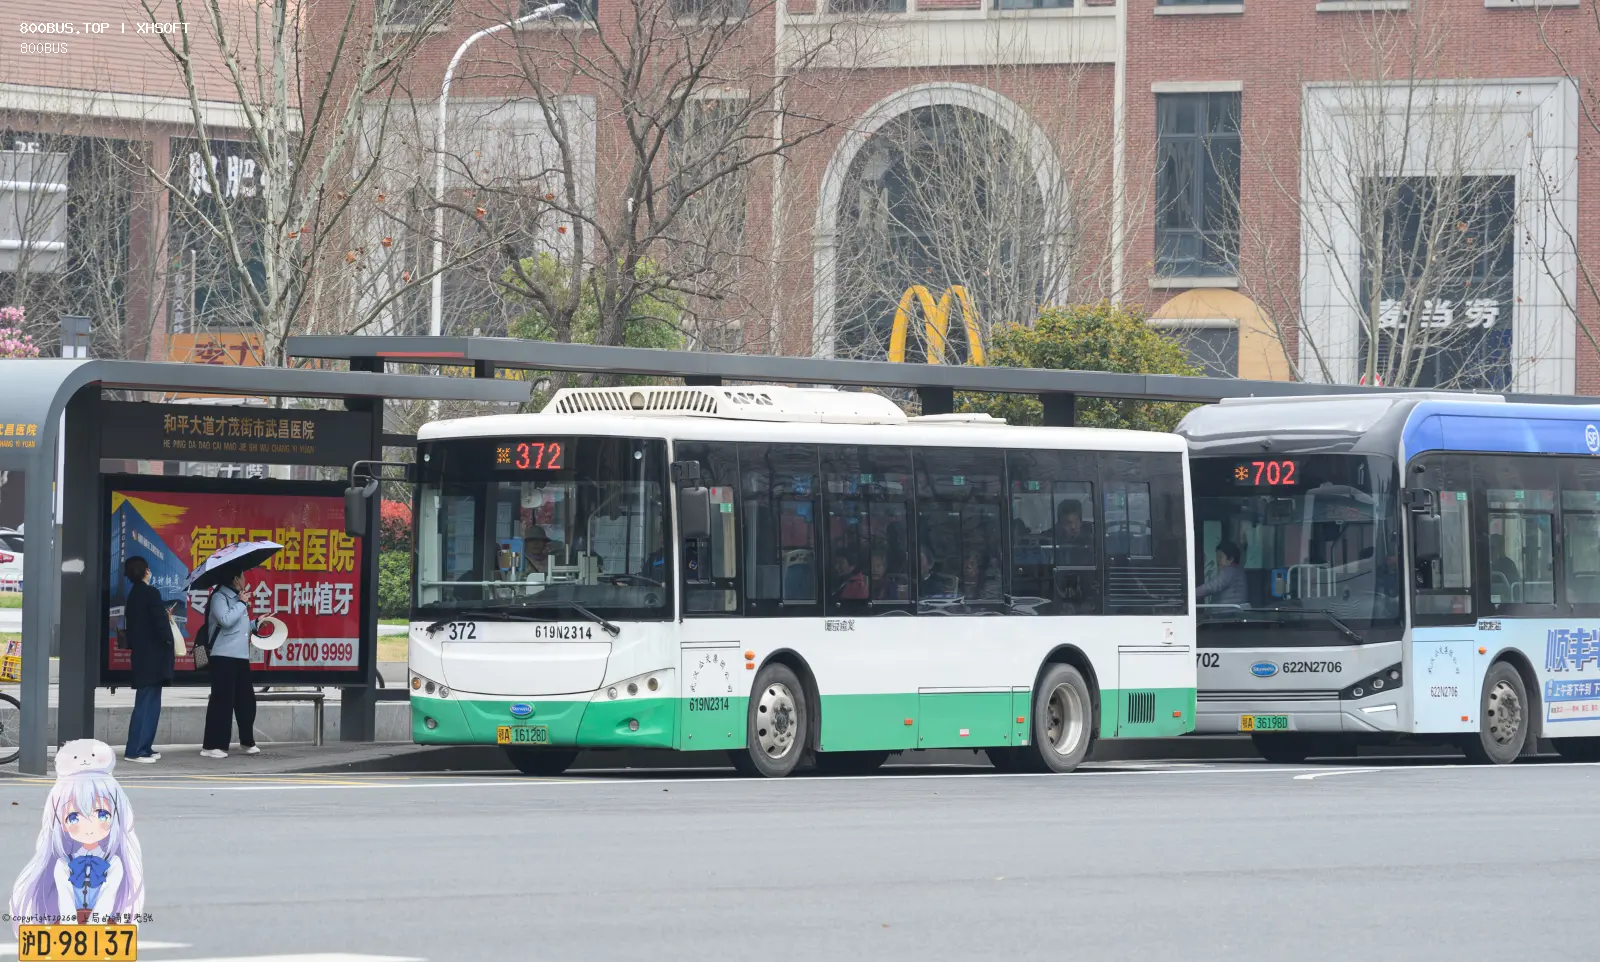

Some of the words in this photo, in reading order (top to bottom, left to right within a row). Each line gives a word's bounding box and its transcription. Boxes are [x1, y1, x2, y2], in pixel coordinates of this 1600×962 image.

[163, 413, 315, 440] 和平大道才茂街市武昌医院
[163, 439, 171, 448] HE
[173, 440, 186, 449] PING
[188, 440, 196, 449] DA
[198, 440, 210, 449] DAO
[212, 441, 222, 450] CAI
[223, 442, 236, 451] MAO
[238, 442, 247, 451] JIE
[249, 443, 258, 452] SHI
[260, 443, 269, 452] WU
[271, 444, 290, 453] CHANG
[300, 445, 315, 454] YUAN
[515, 442, 561, 469] 372
[1252, 460, 1295, 485] 702
[190, 581, 354, 615] 专全口种植牙
[449, 622, 477, 640] 372
[535, 625, 592, 640] 619N2314
[286, 643, 319, 661] 8700
[321, 643, 353, 662] 9999
[1282, 662, 1342, 674] 622N2706
[1430, 686, 1458, 698] 622N2706
[689, 697, 729, 712] 619N2314
